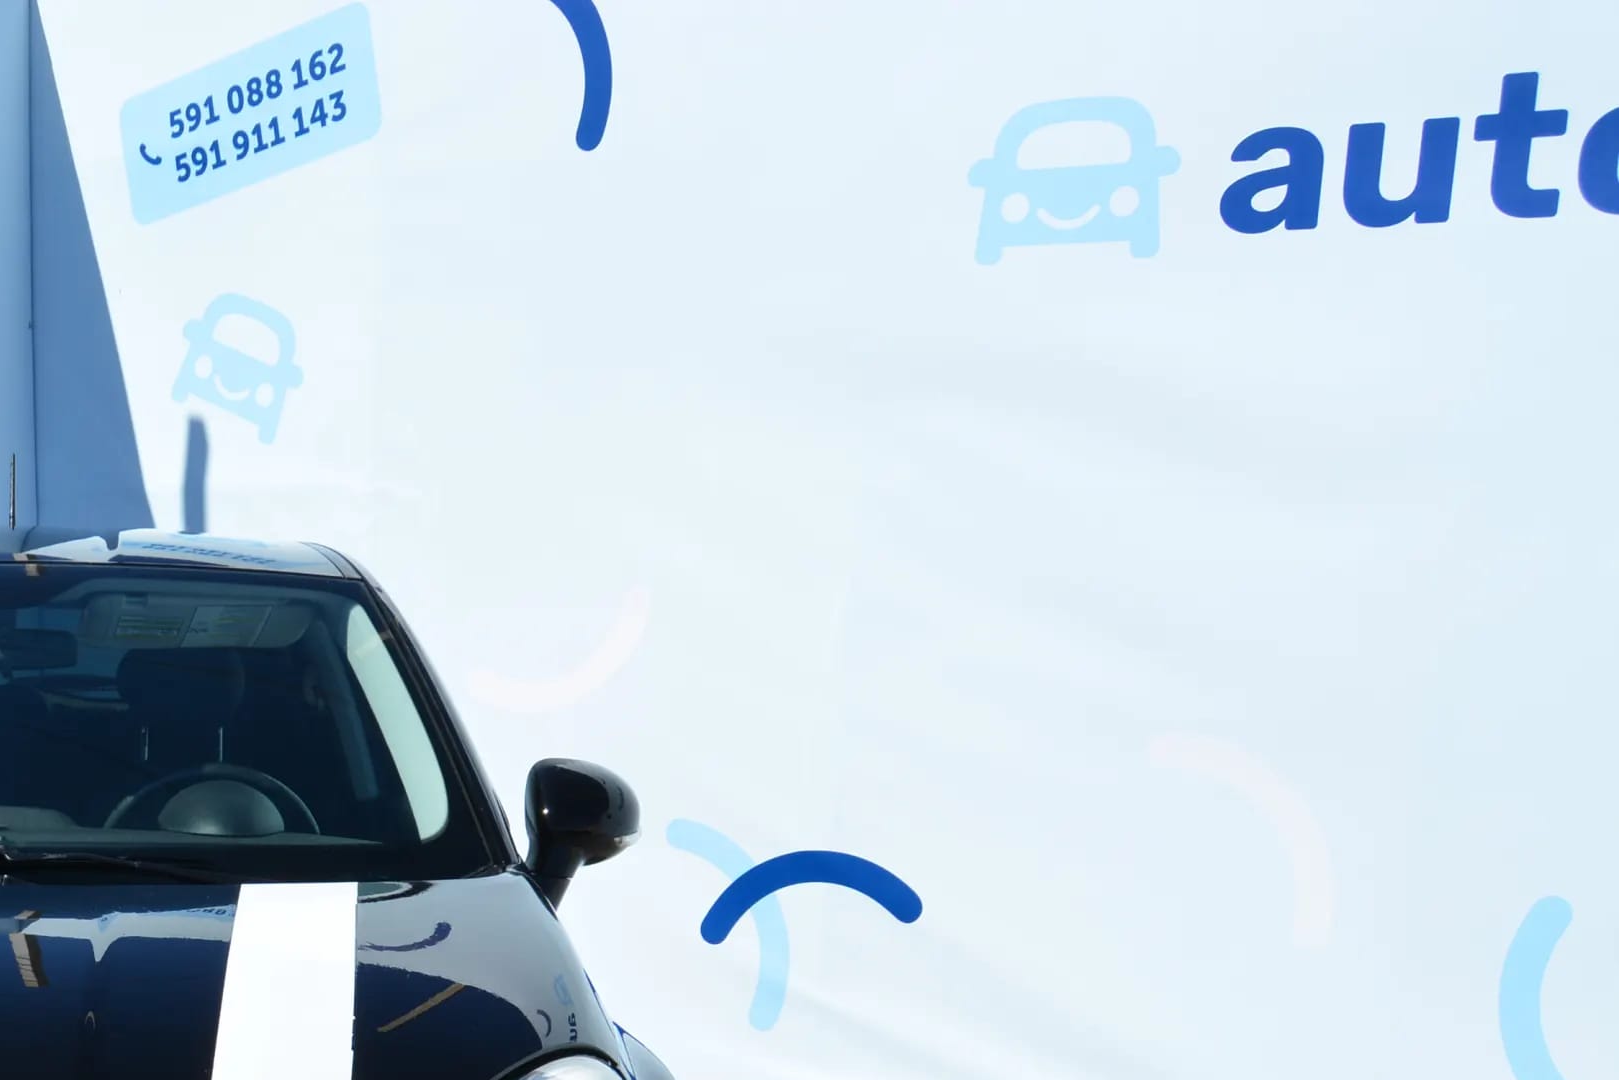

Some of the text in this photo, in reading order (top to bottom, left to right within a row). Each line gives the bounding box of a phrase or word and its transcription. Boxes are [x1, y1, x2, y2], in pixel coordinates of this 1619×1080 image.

[169, 42, 347, 139] 591 088 162
[174, 89, 347, 183] 591 911 143
